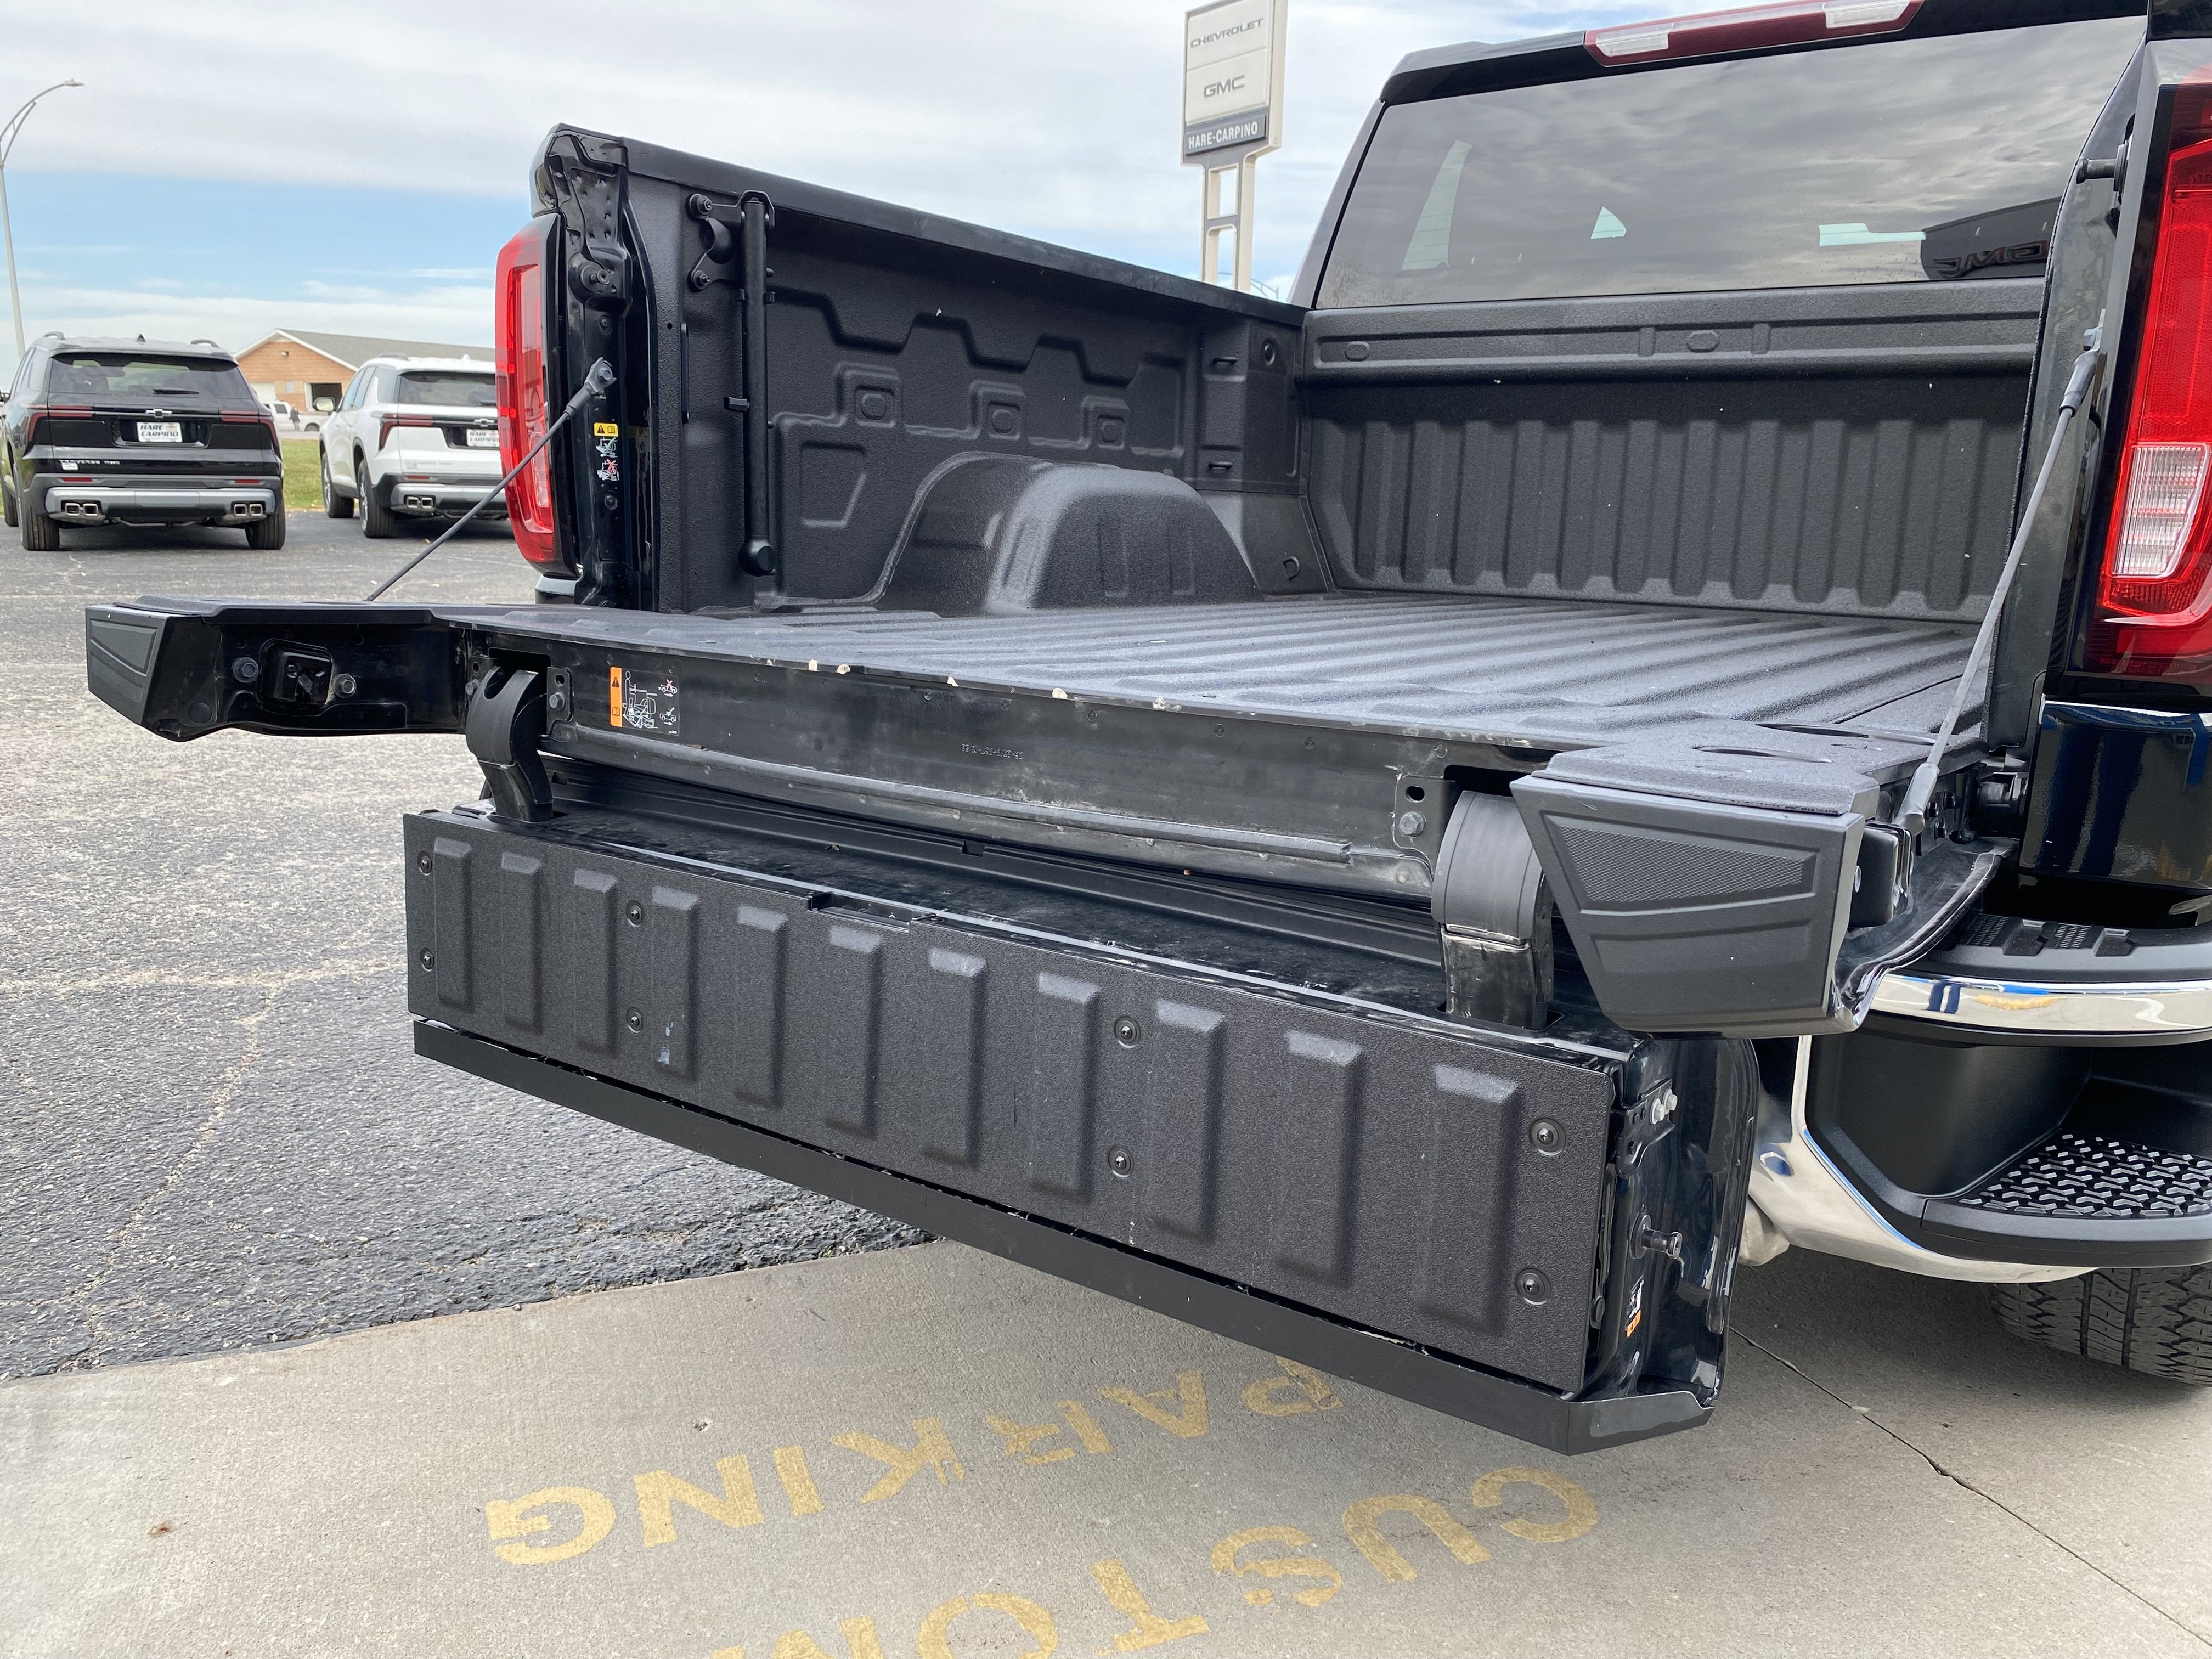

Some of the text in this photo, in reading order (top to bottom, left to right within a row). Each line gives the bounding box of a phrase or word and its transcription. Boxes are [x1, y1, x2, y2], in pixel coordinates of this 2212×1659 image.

[1190, 18, 1263, 48] CHEVROLET
[1203, 75, 1245, 98] GMC
[1188, 121, 1258, 149] HARE-CARPINO
[486, 1353, 1343, 1565] PARKING
[710, 1466, 1598, 1659] CUSTO
